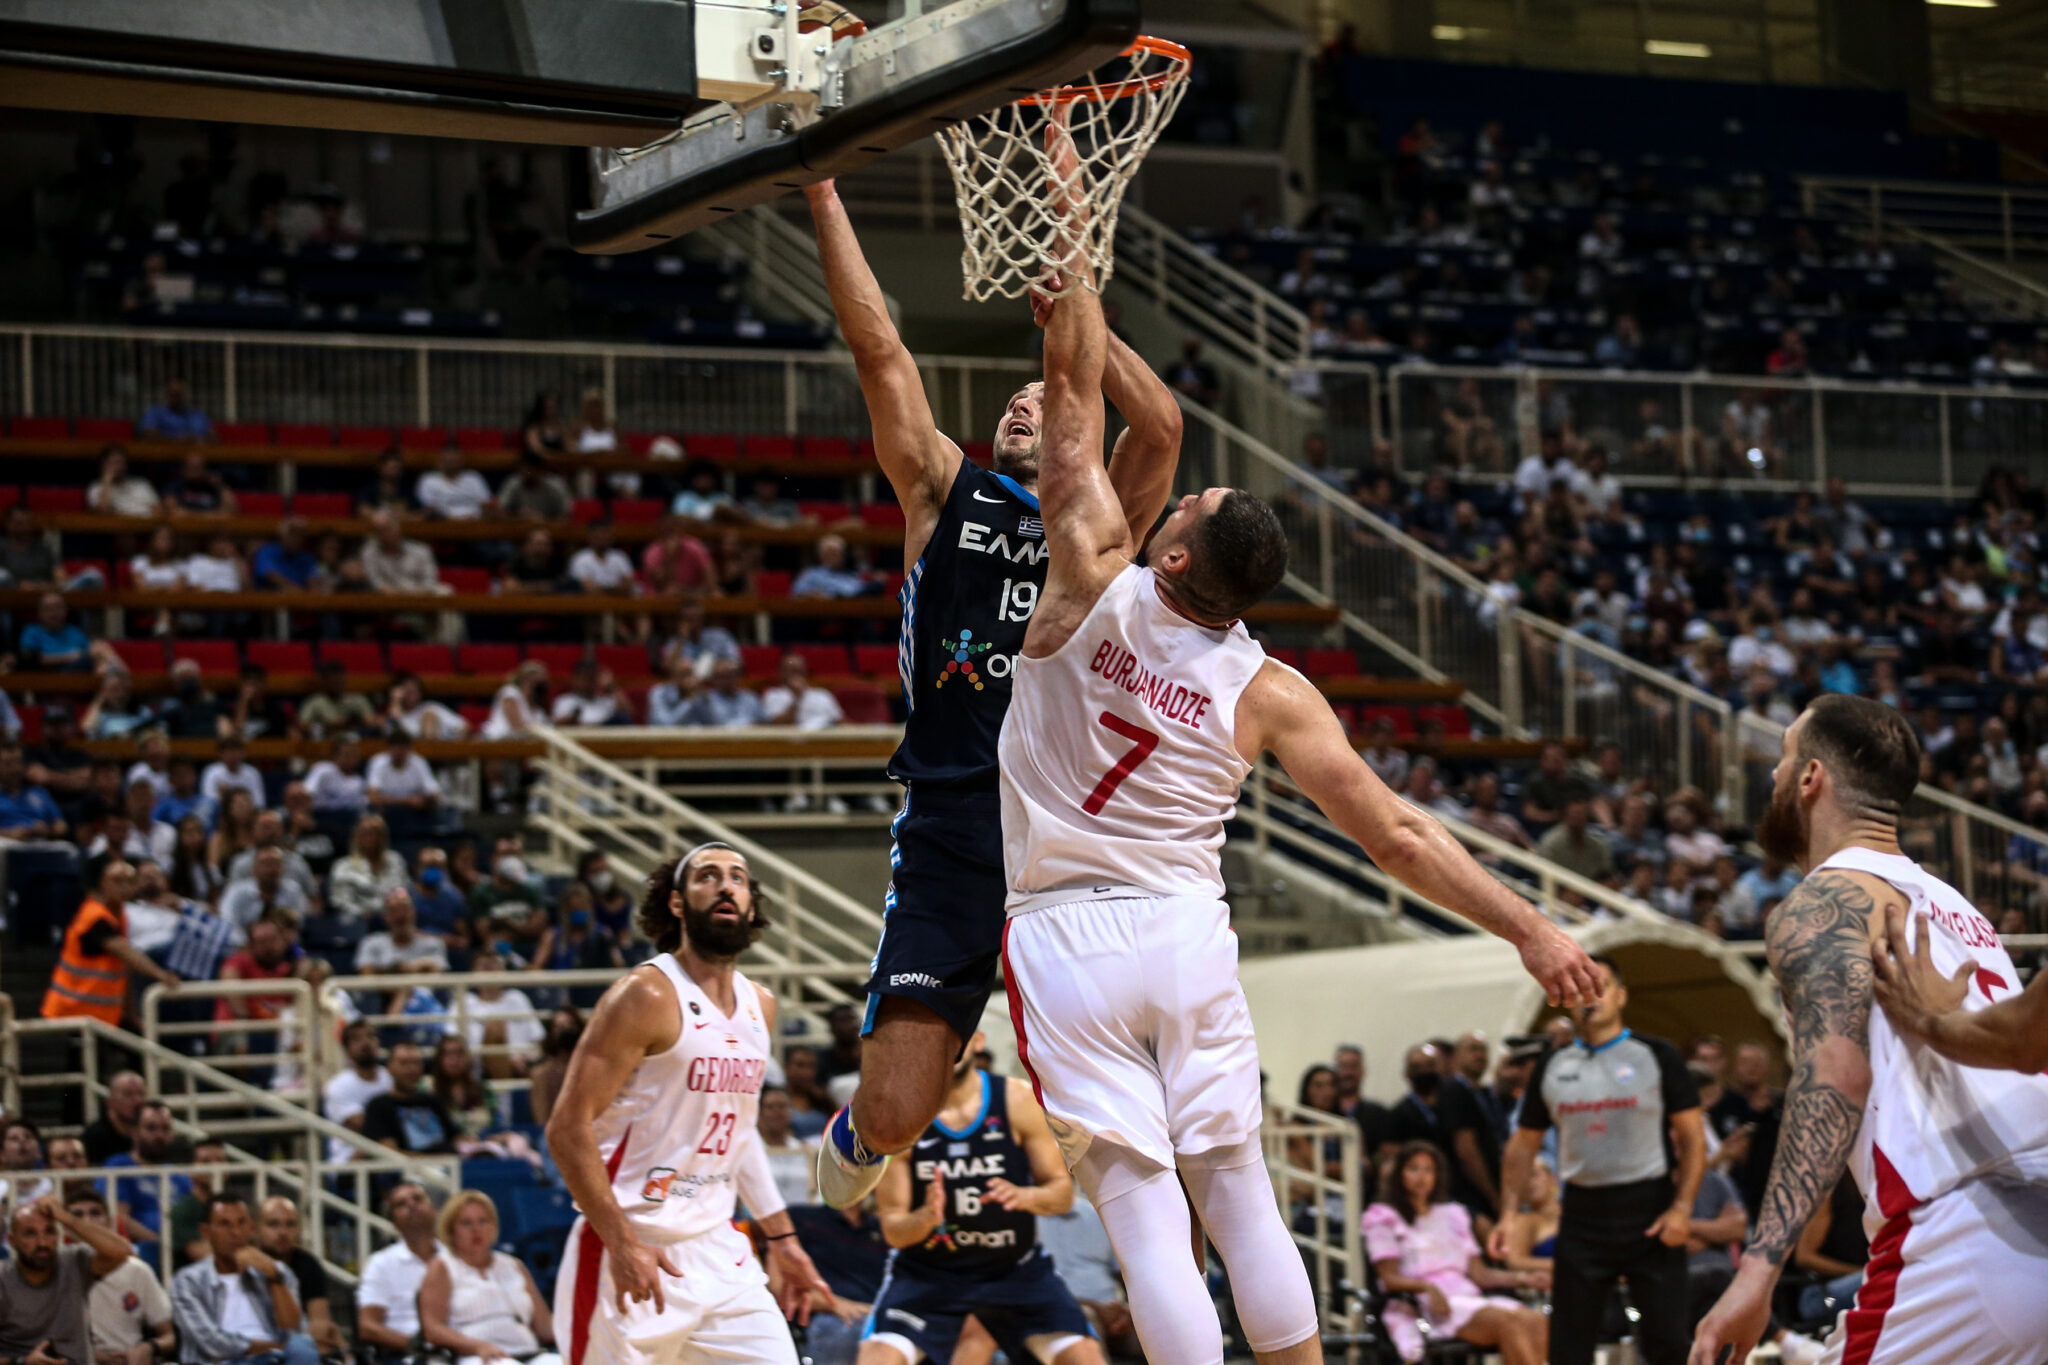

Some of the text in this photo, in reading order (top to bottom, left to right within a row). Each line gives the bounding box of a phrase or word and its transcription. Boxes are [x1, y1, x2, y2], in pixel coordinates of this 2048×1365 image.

[998, 577, 1039, 622] 19
[1089, 638, 1212, 730] BURJANADZE
[1081, 710, 1160, 816] 7
[696, 1111, 737, 1156] 23
[954, 1185, 982, 1216] 16
